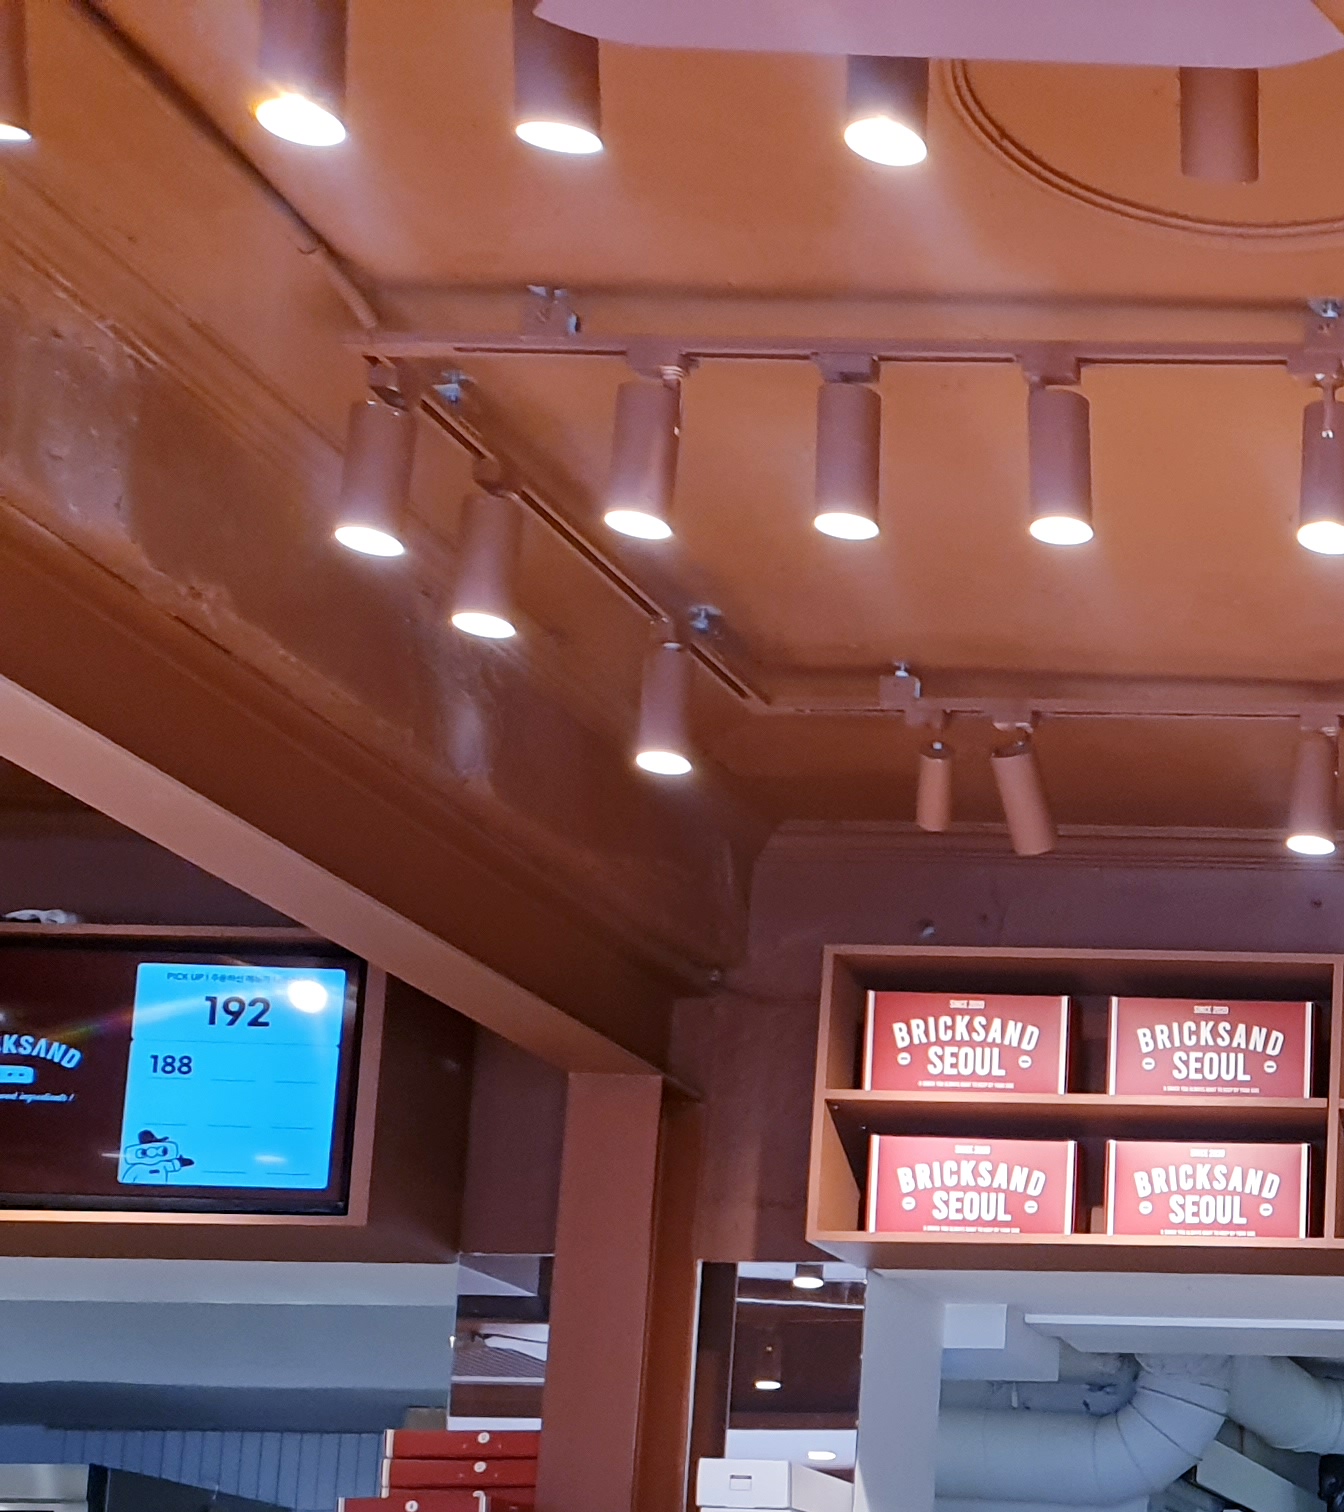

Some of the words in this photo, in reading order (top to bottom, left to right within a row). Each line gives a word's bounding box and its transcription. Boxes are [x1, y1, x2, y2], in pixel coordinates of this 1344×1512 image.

[205, 996, 271, 1028] 192
[893, 1016, 1039, 1052] BRICKSAND
[1137, 1021, 1284, 1057] BRICKSAND
[150, 1054, 193, 1075] 188
[927, 1046, 1005, 1076] SEOUL
[1172, 1051, 1250, 1081] SEOUL
[897, 1160, 1046, 1197] BRICKSAND
[1133, 1163, 1280, 1199] BRICKSAND
[932, 1191, 1011, 1221] SEOUL
[1168, 1194, 1247, 1224] SEOUL
